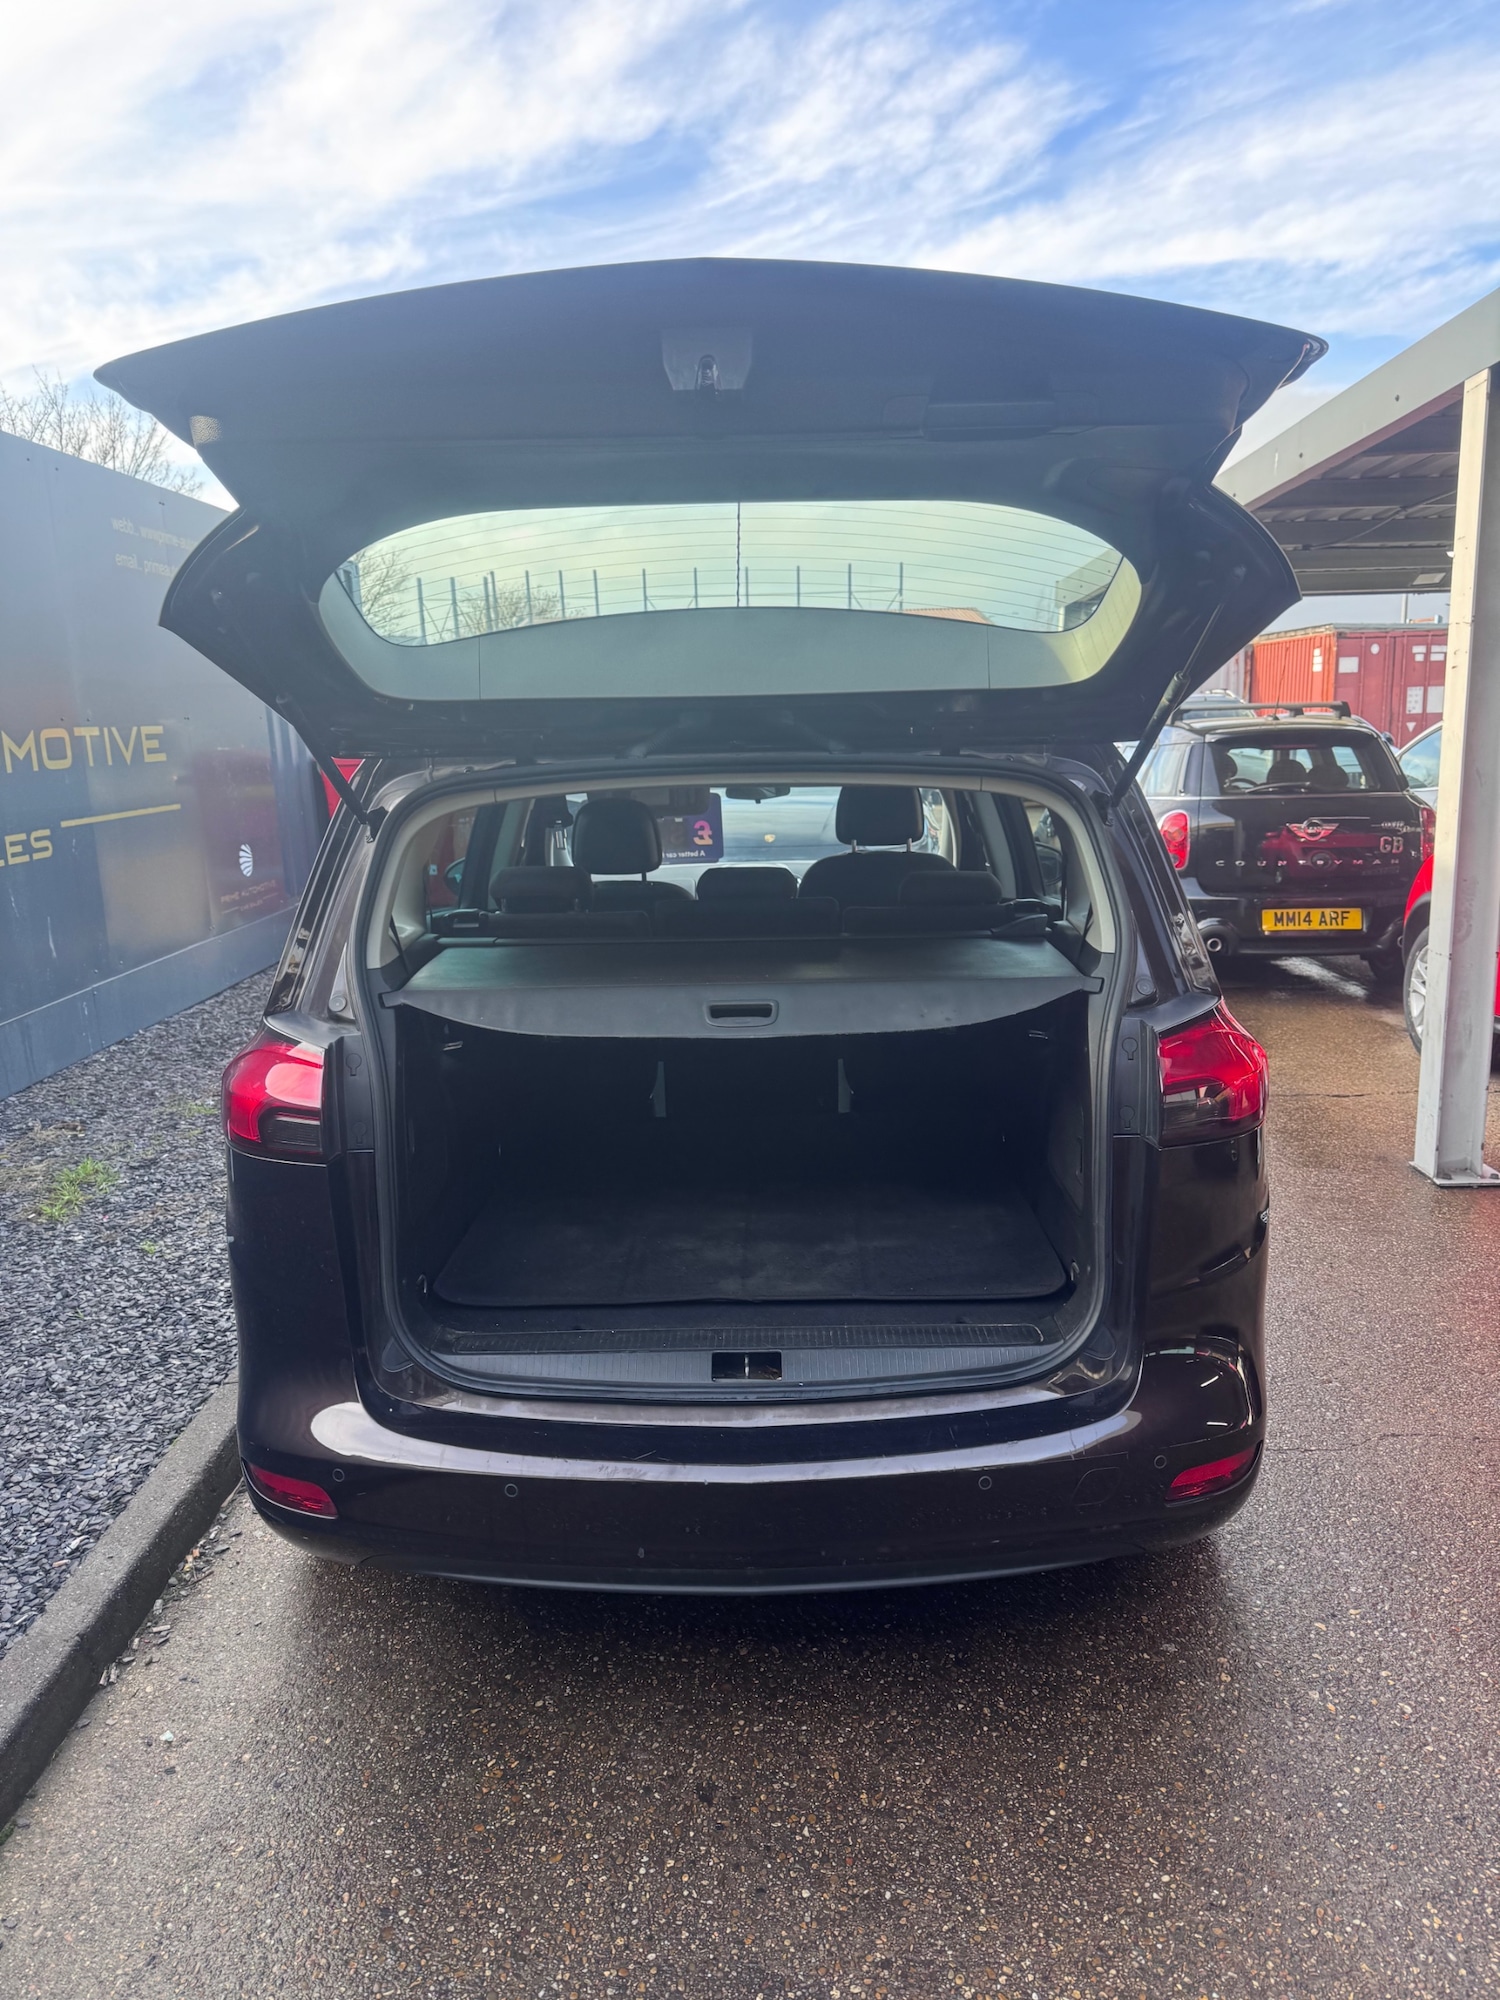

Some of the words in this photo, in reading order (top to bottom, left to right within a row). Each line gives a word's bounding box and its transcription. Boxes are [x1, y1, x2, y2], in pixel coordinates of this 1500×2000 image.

[1, 725, 167, 773] MOTIVE
[1380, 836, 1404, 853] GB
[1216, 858, 1399, 867] COUNTRYMAN
[1274, 911, 1312, 926] MM14
[1319, 911, 1350, 926] ARF
